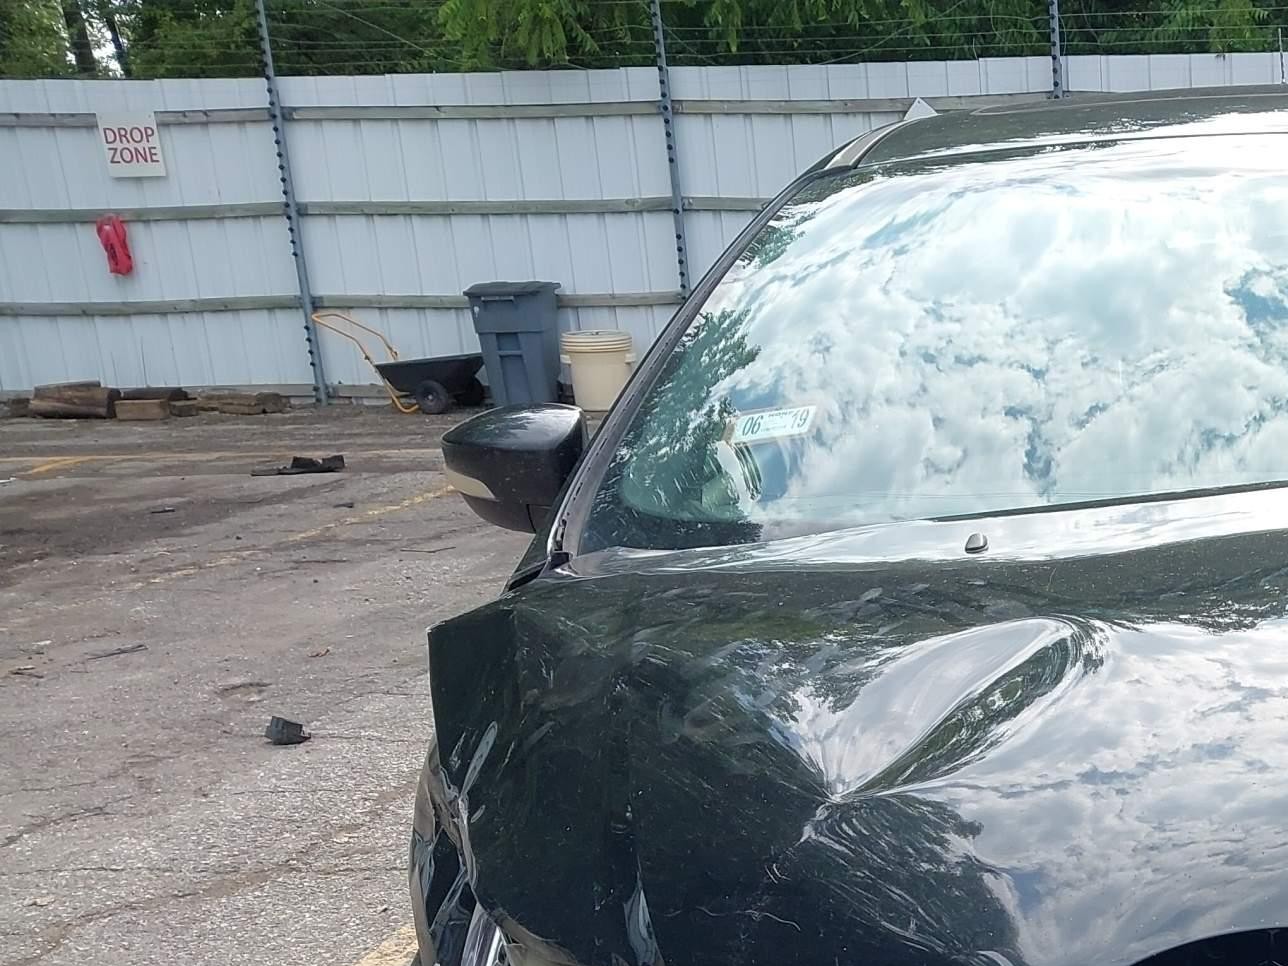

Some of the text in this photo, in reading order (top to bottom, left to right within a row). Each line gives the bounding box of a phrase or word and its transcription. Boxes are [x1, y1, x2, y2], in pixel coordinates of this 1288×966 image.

[103, 126, 155, 144] DROP
[107, 146, 160, 164] ZONE
[742, 415, 764, 436] 06
